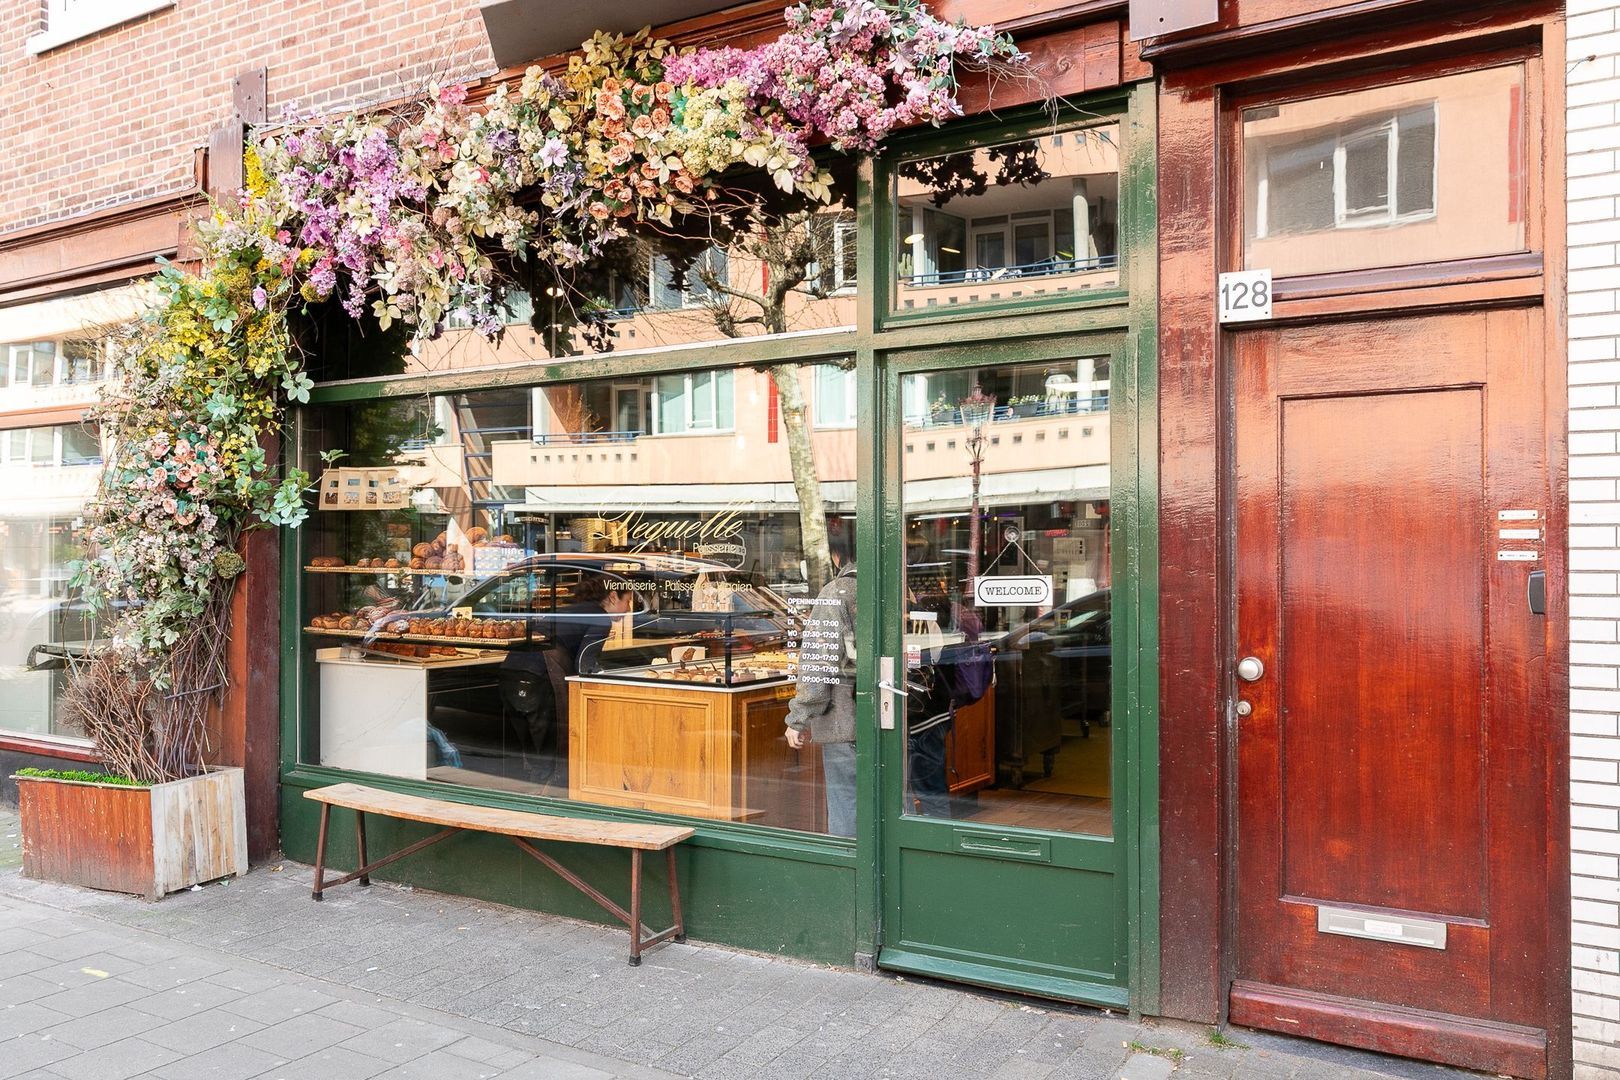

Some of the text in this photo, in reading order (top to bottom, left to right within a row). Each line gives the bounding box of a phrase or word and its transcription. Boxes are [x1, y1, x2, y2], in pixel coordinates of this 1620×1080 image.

[1221, 280, 1268, 311] 128
[603, 579, 657, 591] Viennoiserie
[665, 579, 708, 592] Patissee
[984, 586, 1042, 596] WELCOME
[787, 598, 842, 606] OPENINGSTIJDEN
[787, 629, 798, 637] WO
[802, 641, 839, 650] 07:30-17:00
[802, 653, 839, 662] 07:30-17:00
[802, 664, 839, 673] 07:30-17:00
[787, 674, 841, 685] ZO 09:00-13:00
